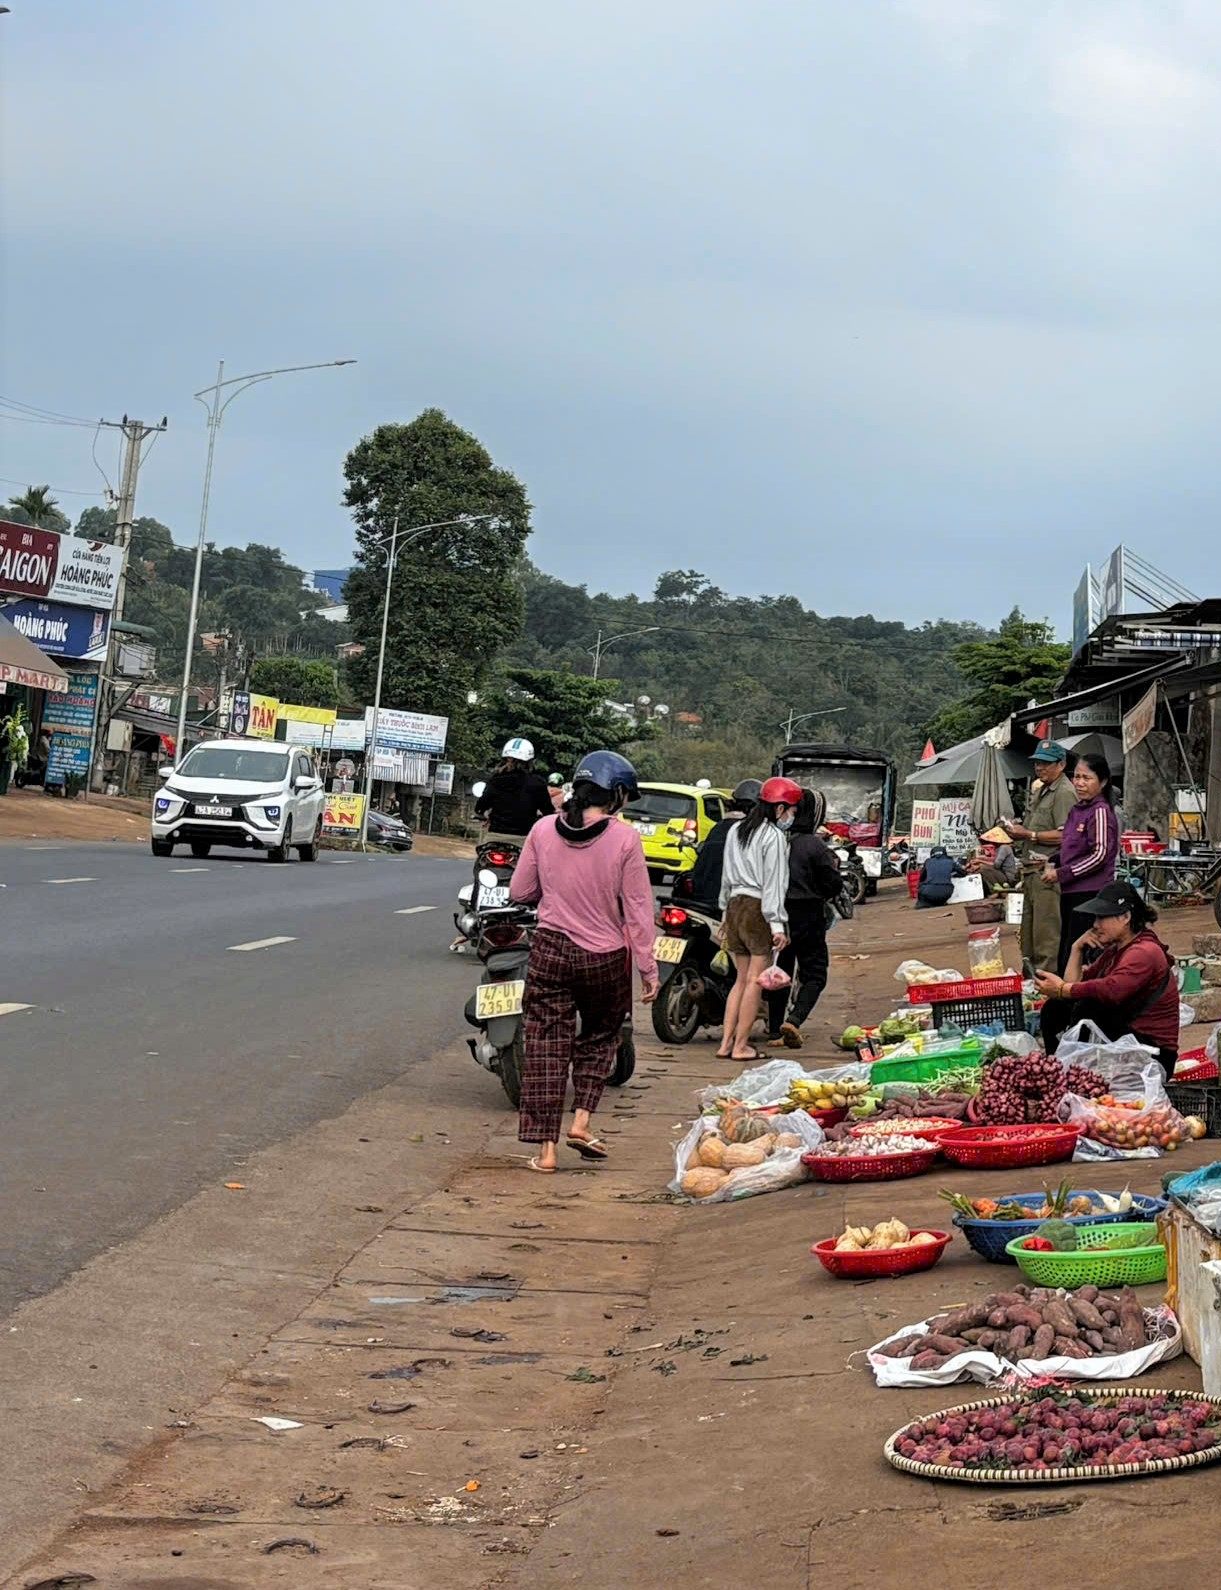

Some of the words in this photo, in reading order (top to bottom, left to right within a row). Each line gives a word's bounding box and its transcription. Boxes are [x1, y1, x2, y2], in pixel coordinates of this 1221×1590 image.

[21, 533, 33, 546] BIA
[61, 562, 91, 585] HOÀNG
[91, 567, 114, 589] PHÚC
[13, 612, 44, 640] HOÀNG
[44, 617, 69, 643] PHÚC
[252, 701, 275, 730] TÂN
[323, 808, 355, 824] ÂN
[915, 803, 937, 820] PHỞ
[913, 822, 933, 839] BÚN
[484, 983, 516, 1001] 47-U1
